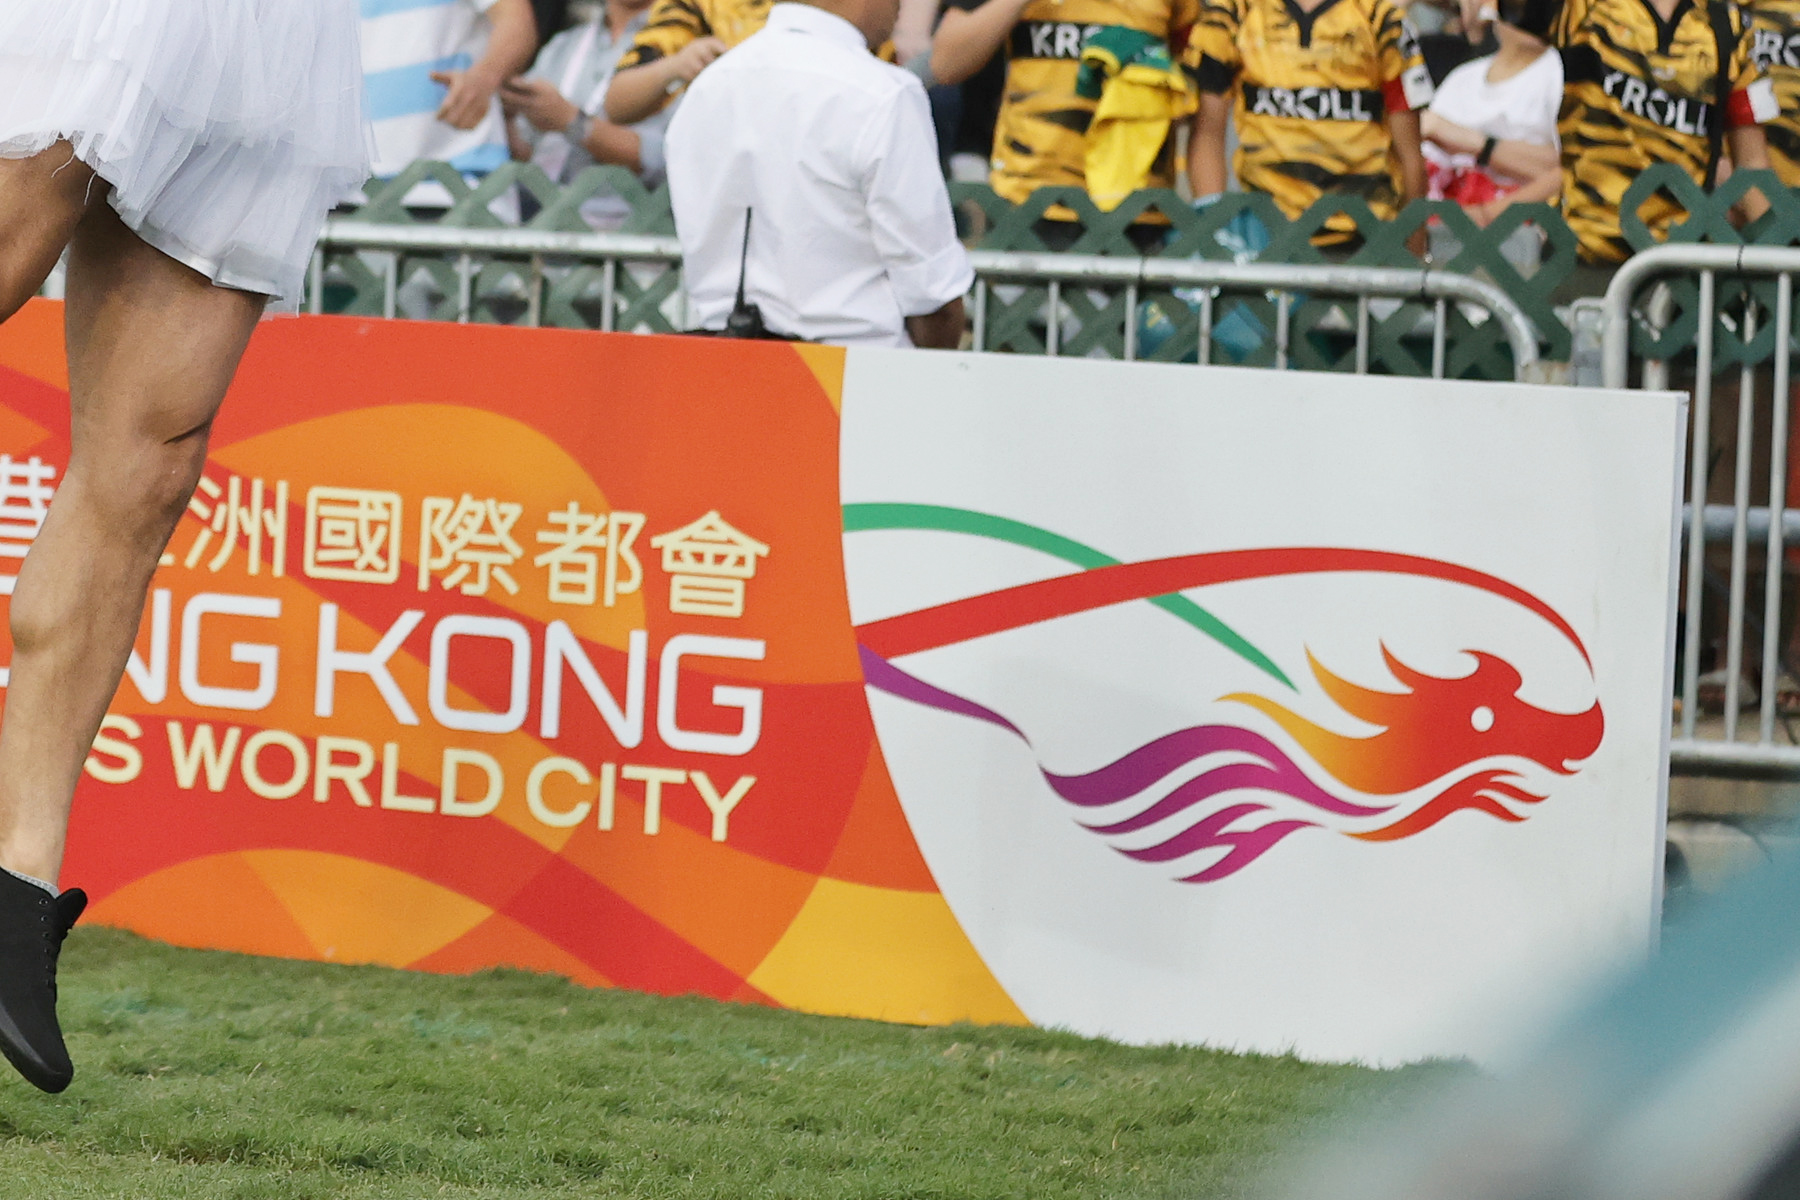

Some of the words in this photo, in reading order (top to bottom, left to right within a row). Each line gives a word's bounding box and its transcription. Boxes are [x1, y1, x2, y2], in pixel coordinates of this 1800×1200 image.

[314, 602, 766, 756] KONG
[166, 721, 504, 818] WORLD
[526, 755, 757, 842] CITY
